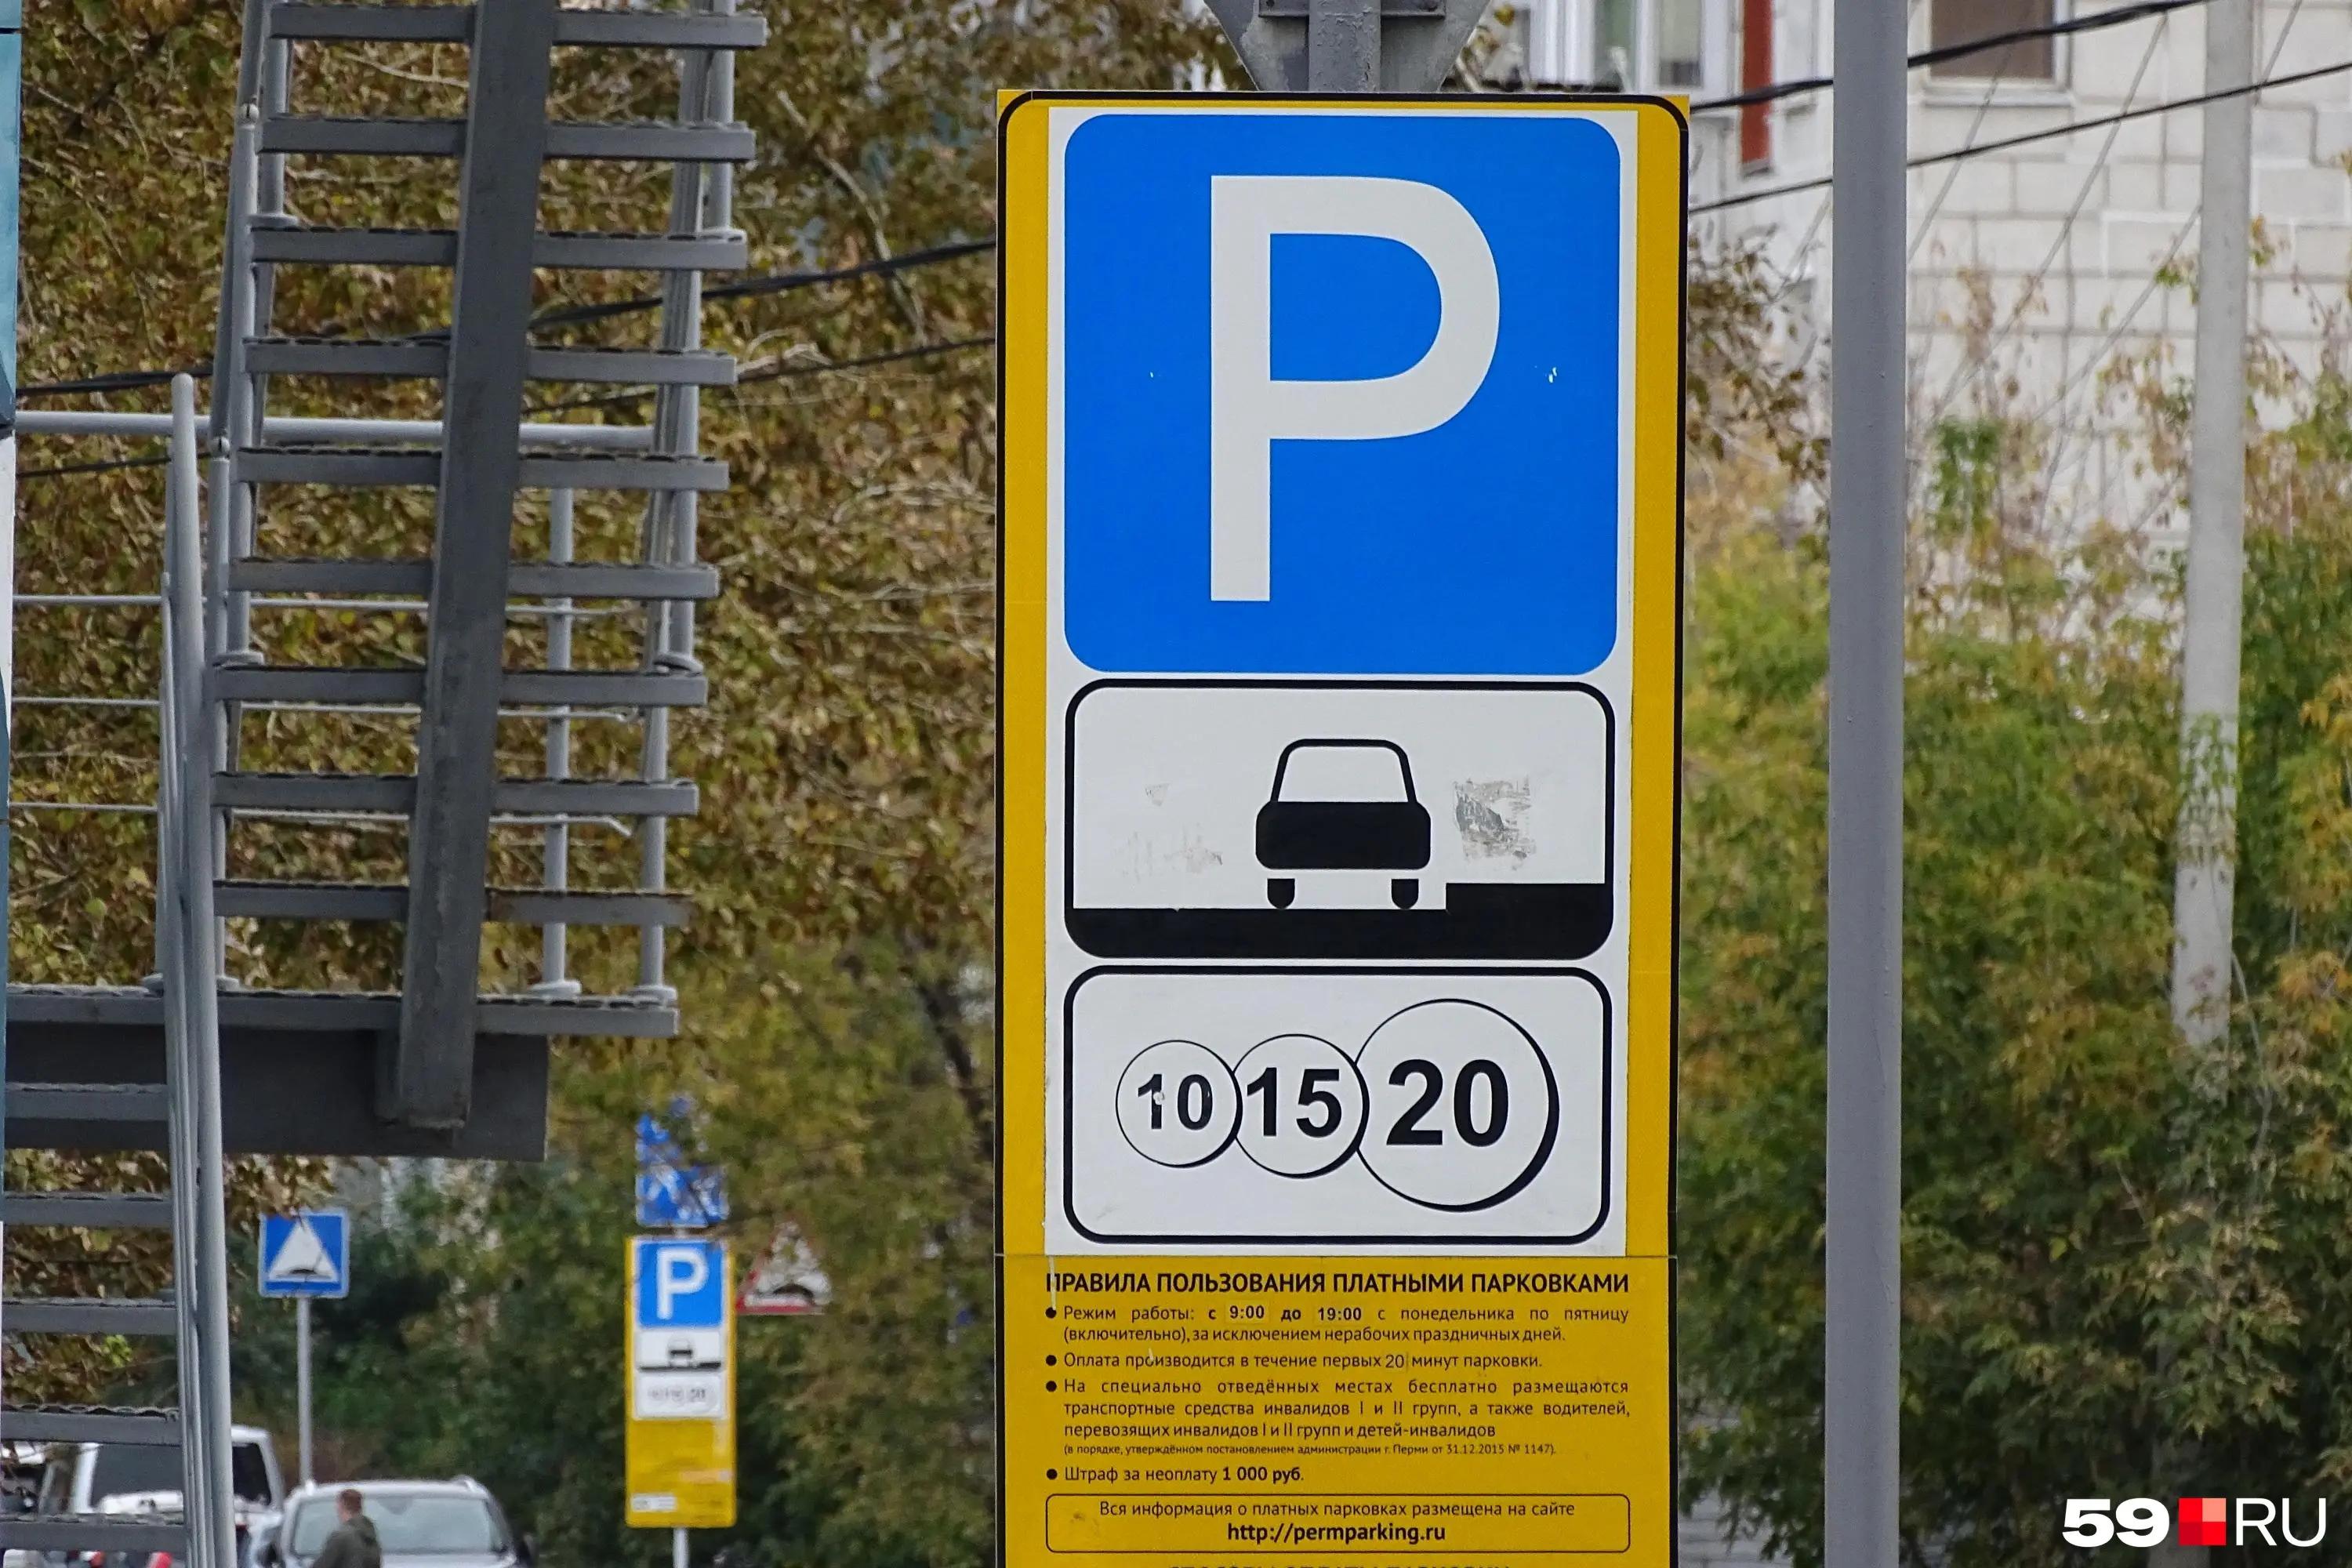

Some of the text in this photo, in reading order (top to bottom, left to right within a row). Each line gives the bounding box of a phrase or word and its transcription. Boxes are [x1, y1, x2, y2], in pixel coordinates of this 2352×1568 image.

[1211, 176, 1500, 601] P
[1138, 1059, 1508, 1146] 10 15 20
[657, 1248, 709, 1319] P
[1046, 1272, 1629, 1294] ПРАВИЛА ПОЛЬЗОВАНИЯ ПЛАТНЫМИ ПАРКОВКАМИ
[1064, 1304, 1629, 1324] Режим работы: с 9:00 до 19:00 с понедельника по пятницу
[1064, 1326, 1566, 1345] (включительно), за исключением нерабочих праздничных дней.
[1064, 1352, 1543, 1370] Оплата производится в течение первых 20 минут парковки.
[1064, 1377, 1628, 1396] На специально отведённых местах бесплатно размещаются
[1063, 1403, 1175, 1418] транспортные
[1185, 1403, 1254, 1418] средства
[1264, 1403, 1350, 1417] инвалидов
[1374, 1404, 1384, 1415] и
[1413, 1403, 1461, 1419] групп,
[1469, 1403, 1478, 1415] а
[1486, 1403, 1534, 1416] также
[1543, 1400, 1630, 1417] водителей,
[1064, 1425, 1171, 1440] перевозящих
[1173, 1425, 1259, 1439] инвалидов
[1270, 1425, 1279, 1437] и
[1297, 1425, 1341, 1441] групп
[1344, 1425, 1354, 1437] и
[1356, 1422, 1496, 1439] детей-инвалидов
[1064, 1444, 1073, 1456] (в
[1125, 1444, 1203, 1456] утверждённом
[1206, 1446, 1295, 1454] постановлением
[1298, 1446, 1381, 1456] администрации
[1392, 1443, 1428, 1456] Перми
[1432, 1446, 1443, 1454] от
[1446, 1443, 1504, 1455] 31.12.2015
[1065, 1465, 1305, 1485] Штраф за неоплату 1 000 руб.
[1100, 1501, 1575, 1519] Вся информация о платных парковках размещена на сайте
[1227, 1522, 1446, 1545] http://permparking.ru
